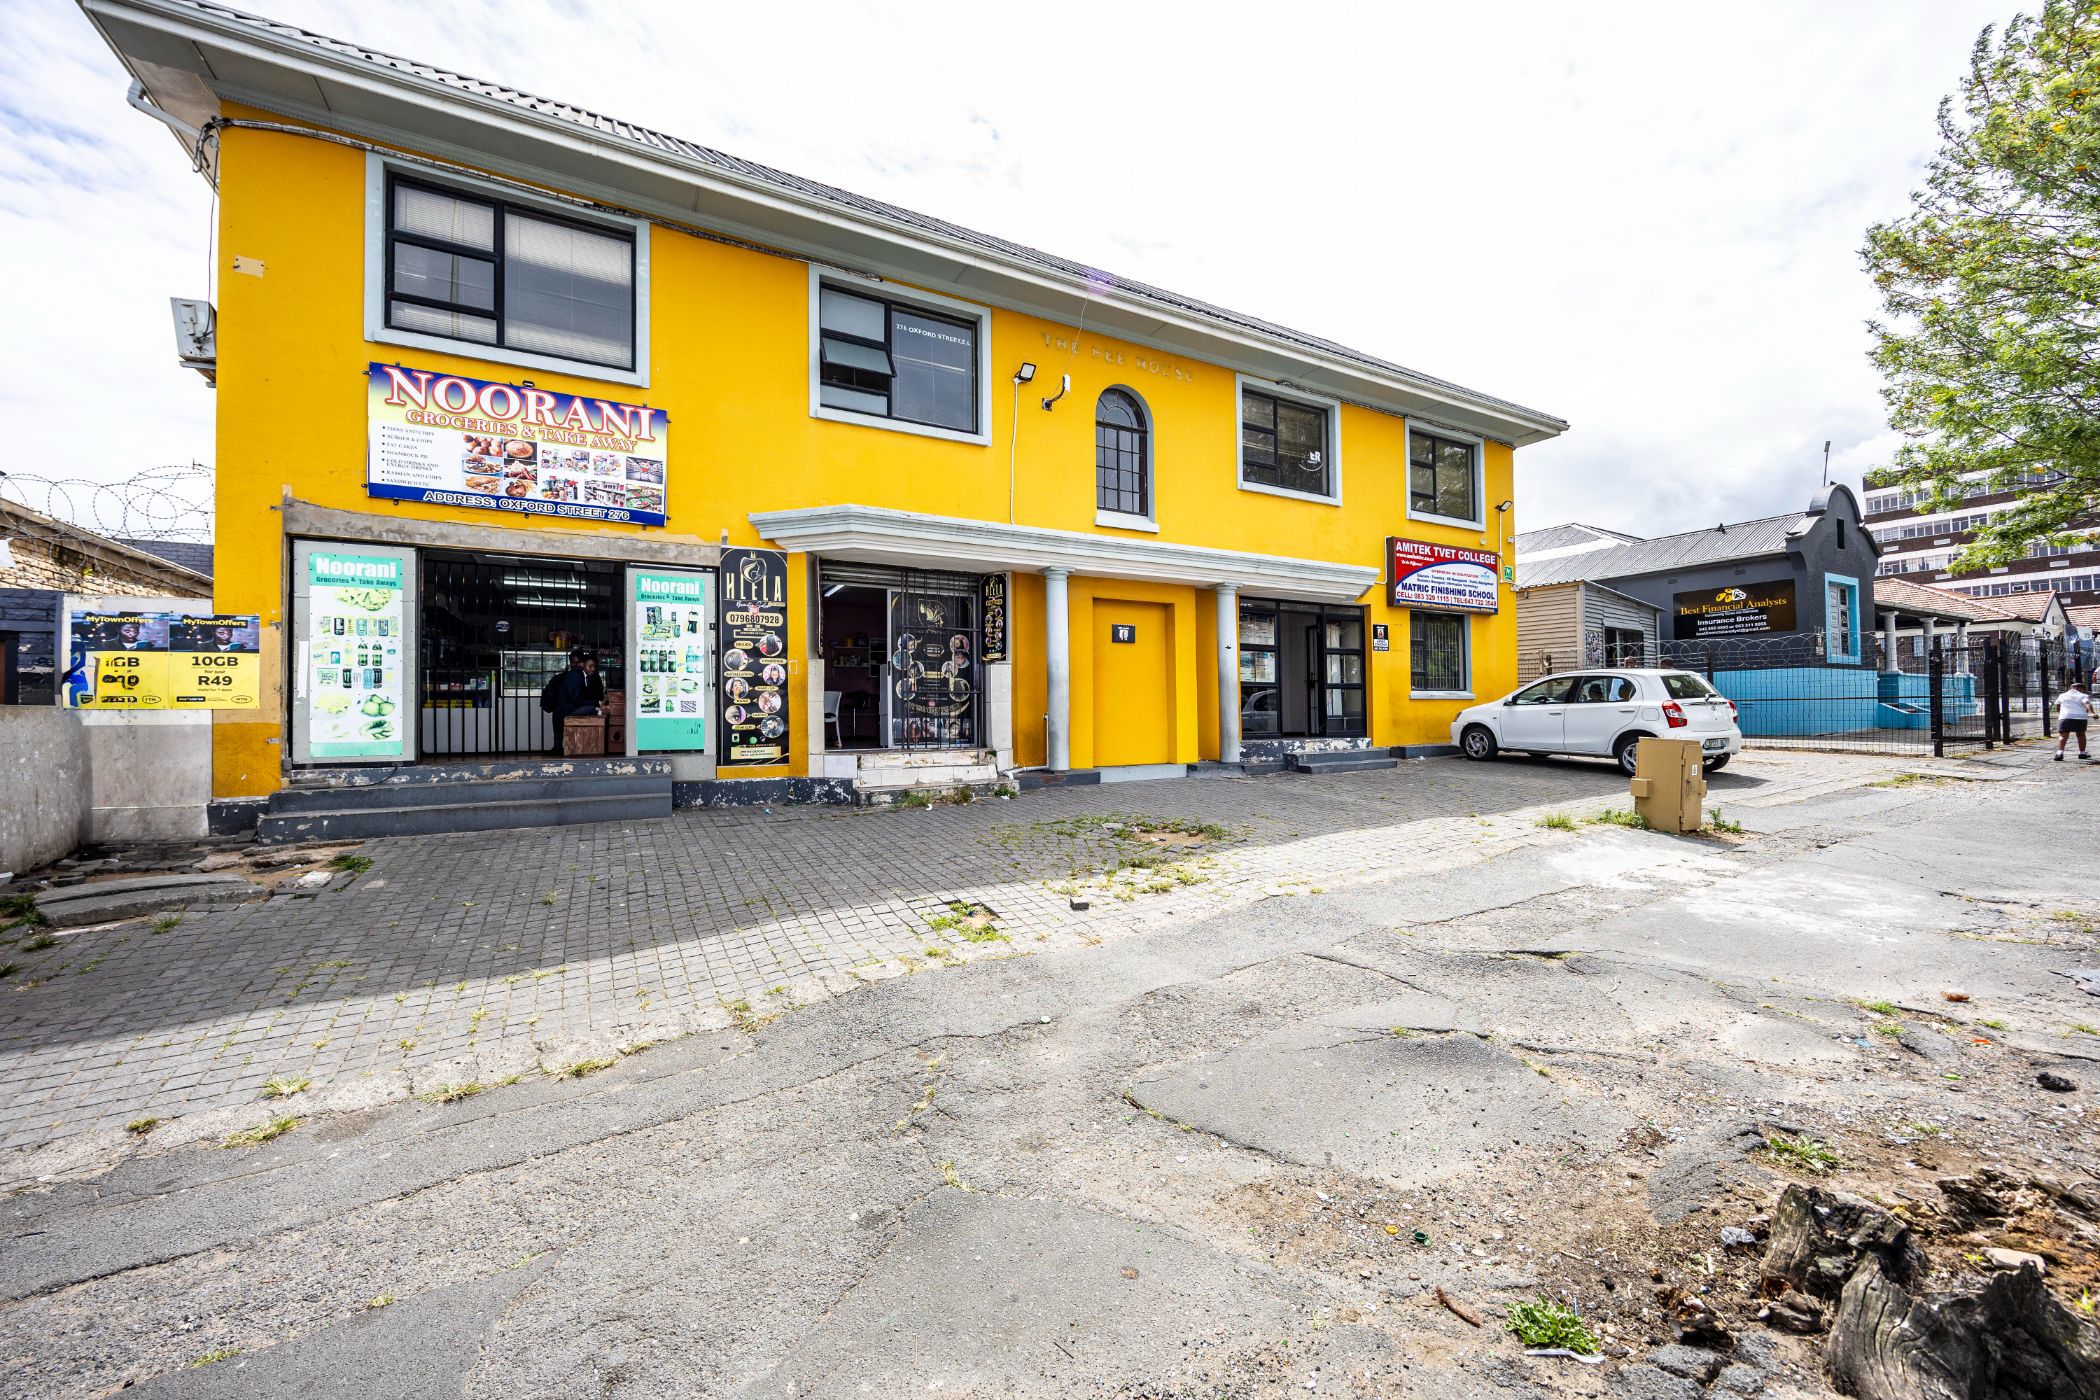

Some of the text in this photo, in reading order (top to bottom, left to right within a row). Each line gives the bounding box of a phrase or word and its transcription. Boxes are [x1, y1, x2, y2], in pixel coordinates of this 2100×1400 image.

[908, 327, 937, 338] OXFORD
[383, 366, 656, 442] NOORANI
[405, 409, 638, 453] GROCERIES & TAKE AWAY
[423, 490, 630, 520] ADDRESS: OXFORD STREET 276
[1396, 541, 1431, 555] AMITEK
[1433, 547, 1456, 559] TVET
[1458, 551, 1496, 564] COLLEGE
[316, 557, 396, 578] Noorani
[316, 576, 349, 584] Groceries
[376, 579, 397, 587] Aways
[641, 577, 700, 594] Noorani
[726, 572, 782, 602] HLELA
[1396, 591, 1413, 599] CELL:
[1475, 598, 1484, 606] 722
[1401, 582, 1495, 600] MATRIC FINISHING SCHOOL
[1680, 607, 1699, 615] Best
[1702, 601, 1743, 613] Financial
[1747, 598, 1788, 608] Analysts
[85, 616, 154, 624] MyTownOffers
[183, 619, 247, 627] MyTownOffers
[730, 613, 780, 624] 0796807928
[1697, 614, 1767, 626] Insurance Brokers
[192, 656, 239, 666] 10GB
[198, 675, 233, 686] R49
